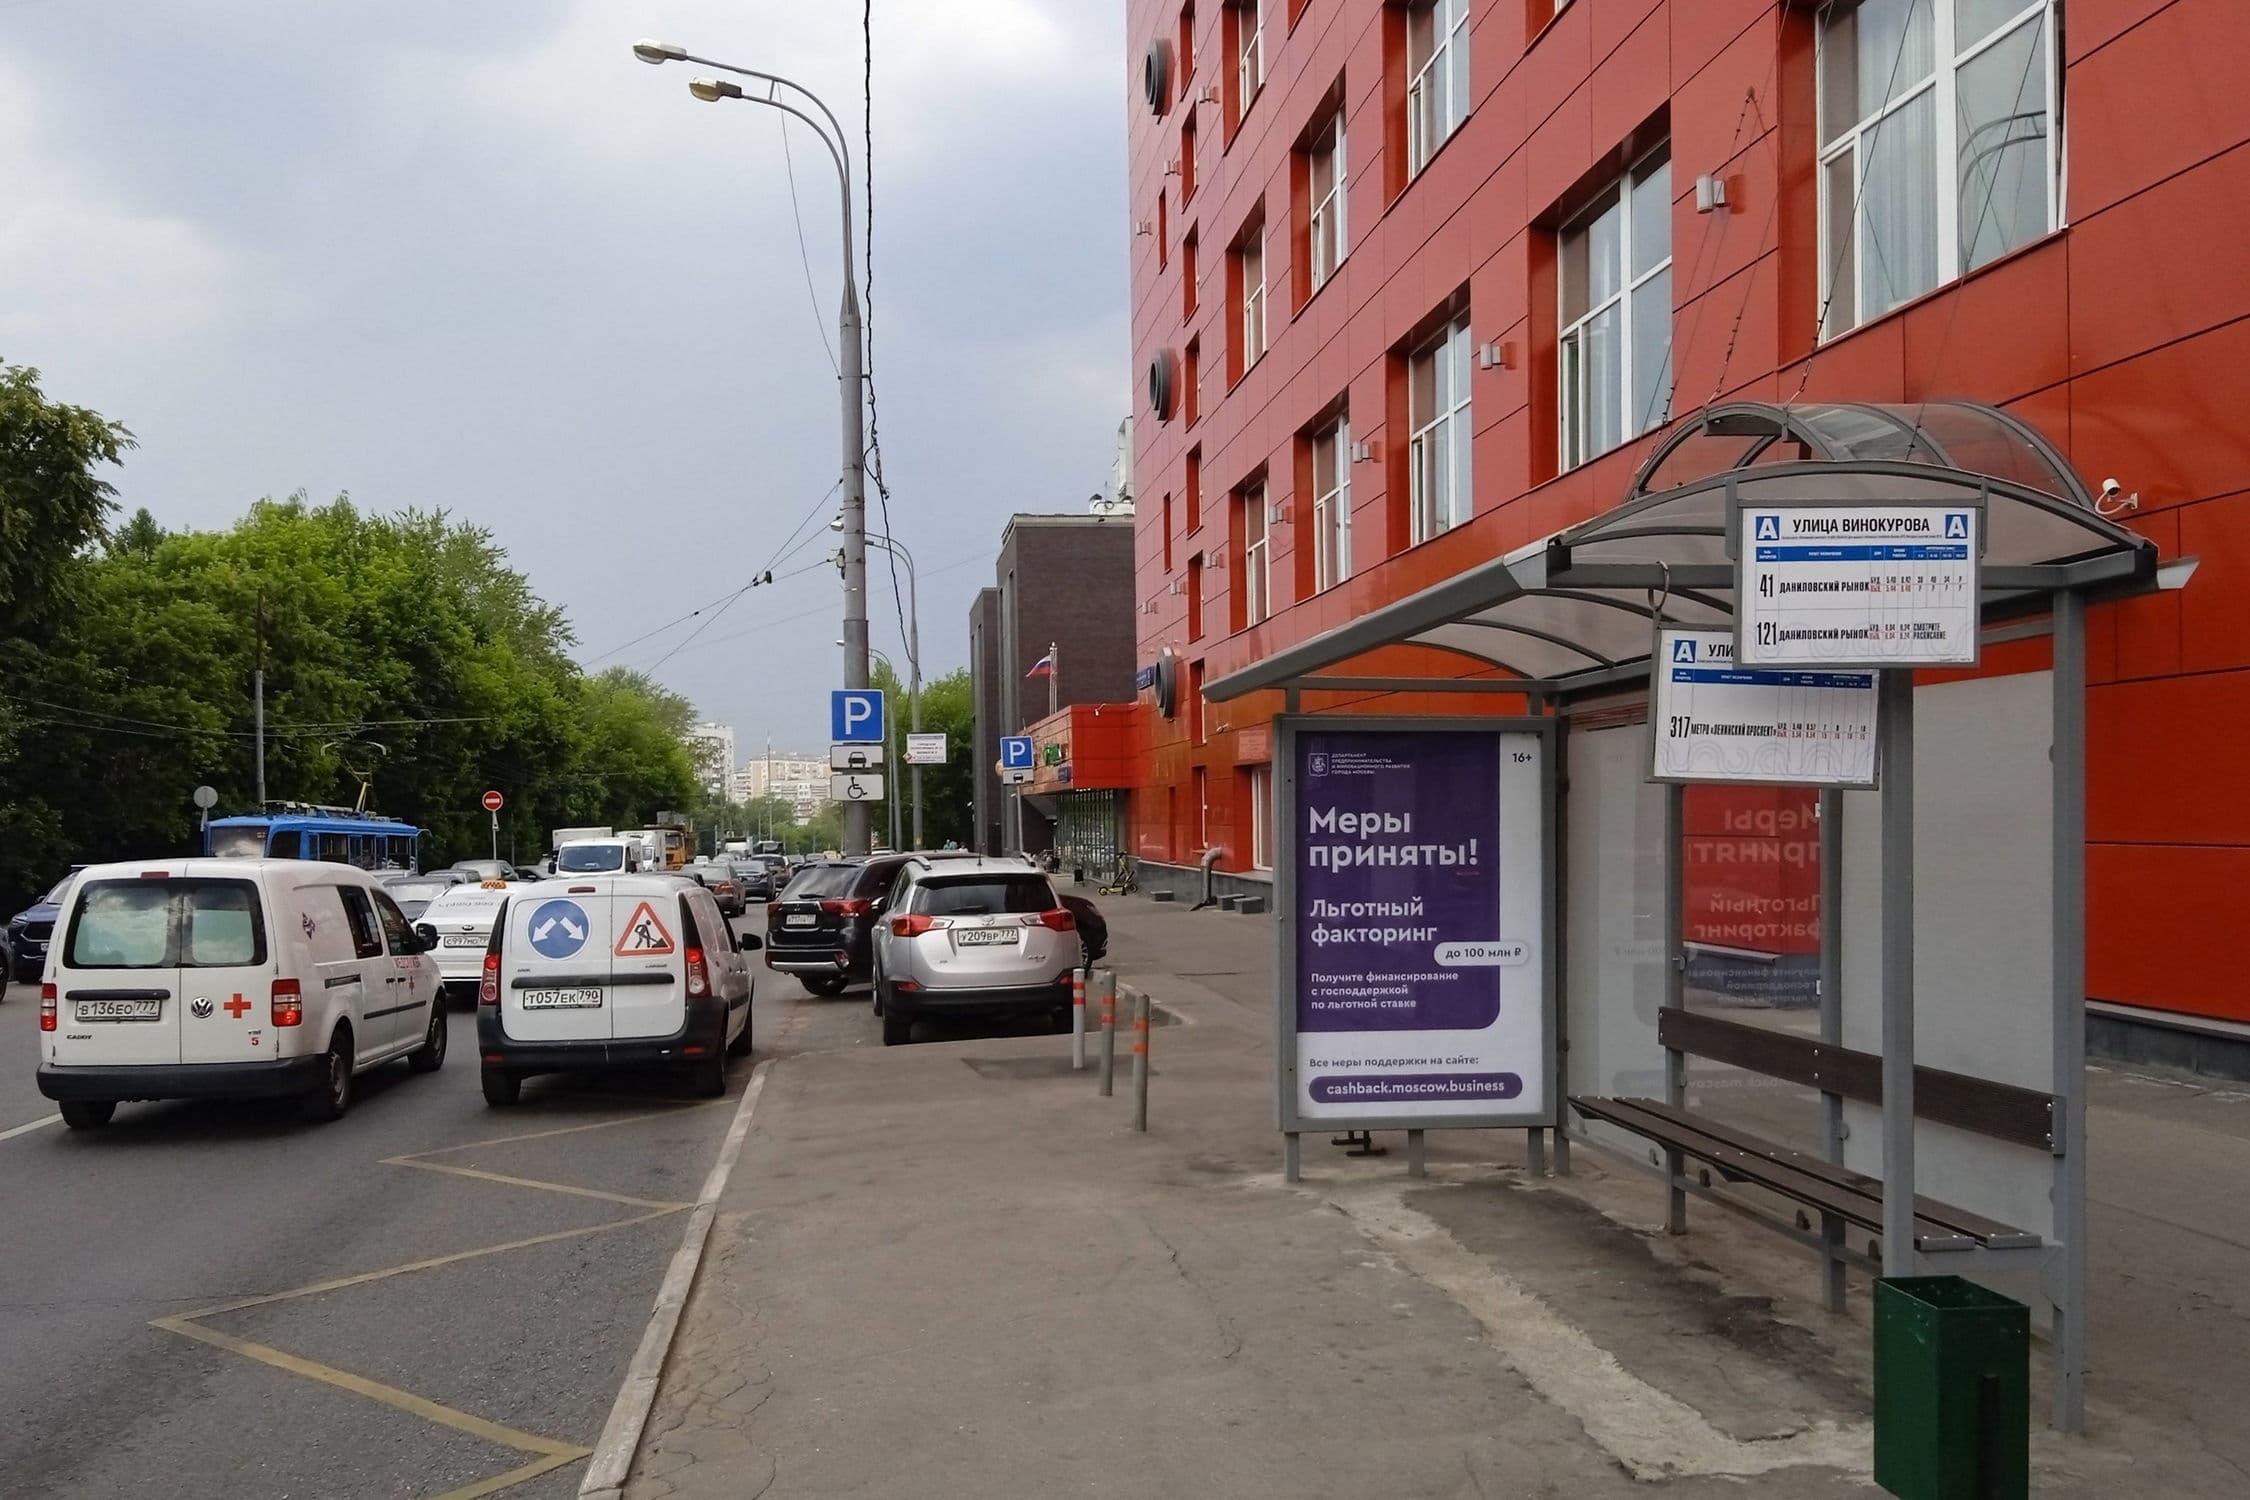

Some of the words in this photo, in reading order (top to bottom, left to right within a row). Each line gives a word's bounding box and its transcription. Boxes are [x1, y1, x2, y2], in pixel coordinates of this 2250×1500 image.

[1793, 518, 1839, 534] УЛИЦА
[1842, 518, 1930, 532] ВИНОКУРОВА
[1760, 574, 1774, 598] 41
[1779, 580, 1840, 594] ДАНИЛОВСКИЙ
[1841, 581, 1869, 593] РЫНОК
[1757, 621, 1777, 646] 121
[1779, 628, 1839, 642] ДАНИЛОВСКИЙ
[1840, 629, 1869, 640] РЫНОК
[844, 696, 872, 735] P
[1670, 715, 1691, 739] 317
[1691, 723, 1710, 735] МЕТРО
[1009, 741, 1026, 765] P
[1512, 752, 1533, 763] 16+
[1309, 806, 1411, 840] Меры
[1309, 838, 1479, 873] приняты!
[1310, 896, 1424, 917] Льготный
[1311, 922, 1438, 947] факторинг
[1445, 949, 1461, 960] до
[1464, 948, 1485, 958] 100
[1488, 948, 1512, 958] млн
[1311, 973, 1363, 984] Получите
[1366, 970, 1459, 983] финансирование
[528, 990, 577, 1005] Т057ЕК
[1311, 988, 1318, 996] с
[1320, 985, 1409, 997] господдержкой
[80, 1000, 133, 1015] В136ЕО
[1311, 1001, 1325, 1010] по
[1327, 998, 1378, 1009] льготной
[1380, 1000, 1417, 1008] ставке
[251, 1037, 259, 1046] 5
[1309, 1058, 1329, 1067] Все
[1332, 1058, 1362, 1069] меры
[1365, 1056, 1427, 1068] поддержки
[1430, 1057, 1443, 1065] на
[1446, 1054, 1479, 1065] сайте:
[1326, 1079, 1505, 1096] cashback.moscow.business
